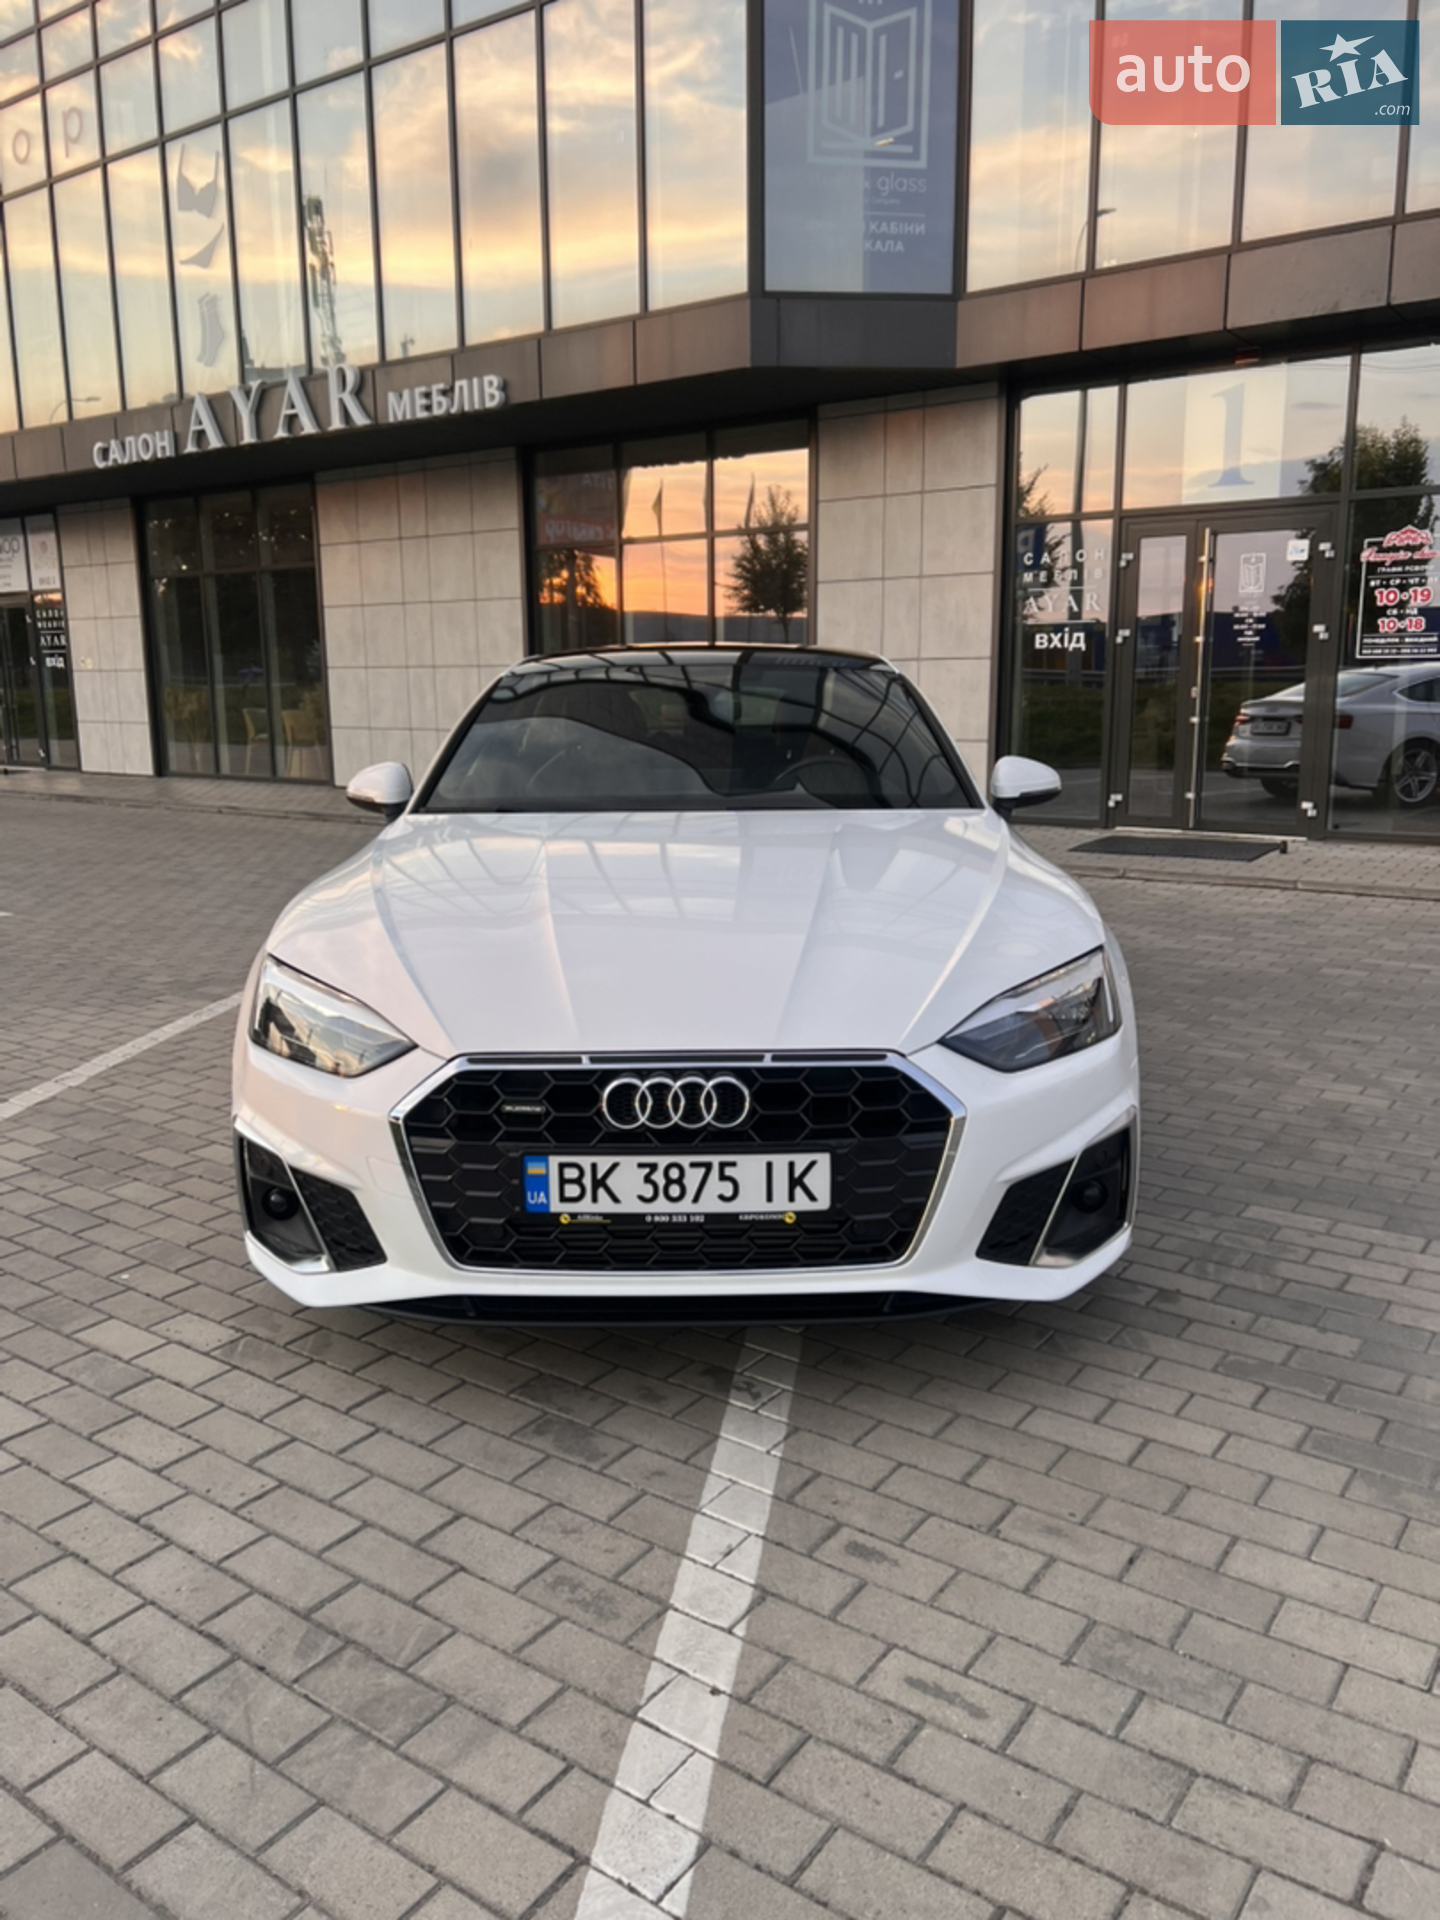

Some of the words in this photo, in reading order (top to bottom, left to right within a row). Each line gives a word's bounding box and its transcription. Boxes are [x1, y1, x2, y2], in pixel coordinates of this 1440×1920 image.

[877, 172, 927, 197] glass
[869, 221, 926, 236] КАБІНИ
[92, 430, 175, 469] САЛОН
[184, 363, 373, 454] AYAR
[387, 374, 506, 423] МЕБЛІВ
[1207, 382, 1255, 488] 1
[1022, 591, 1102, 614] AYAR
[557, 1161, 622, 1204] BK
[636, 1160, 740, 1205] 3875
[765, 1159, 819, 1204] IK
[527, 1191, 548, 1205] UA
